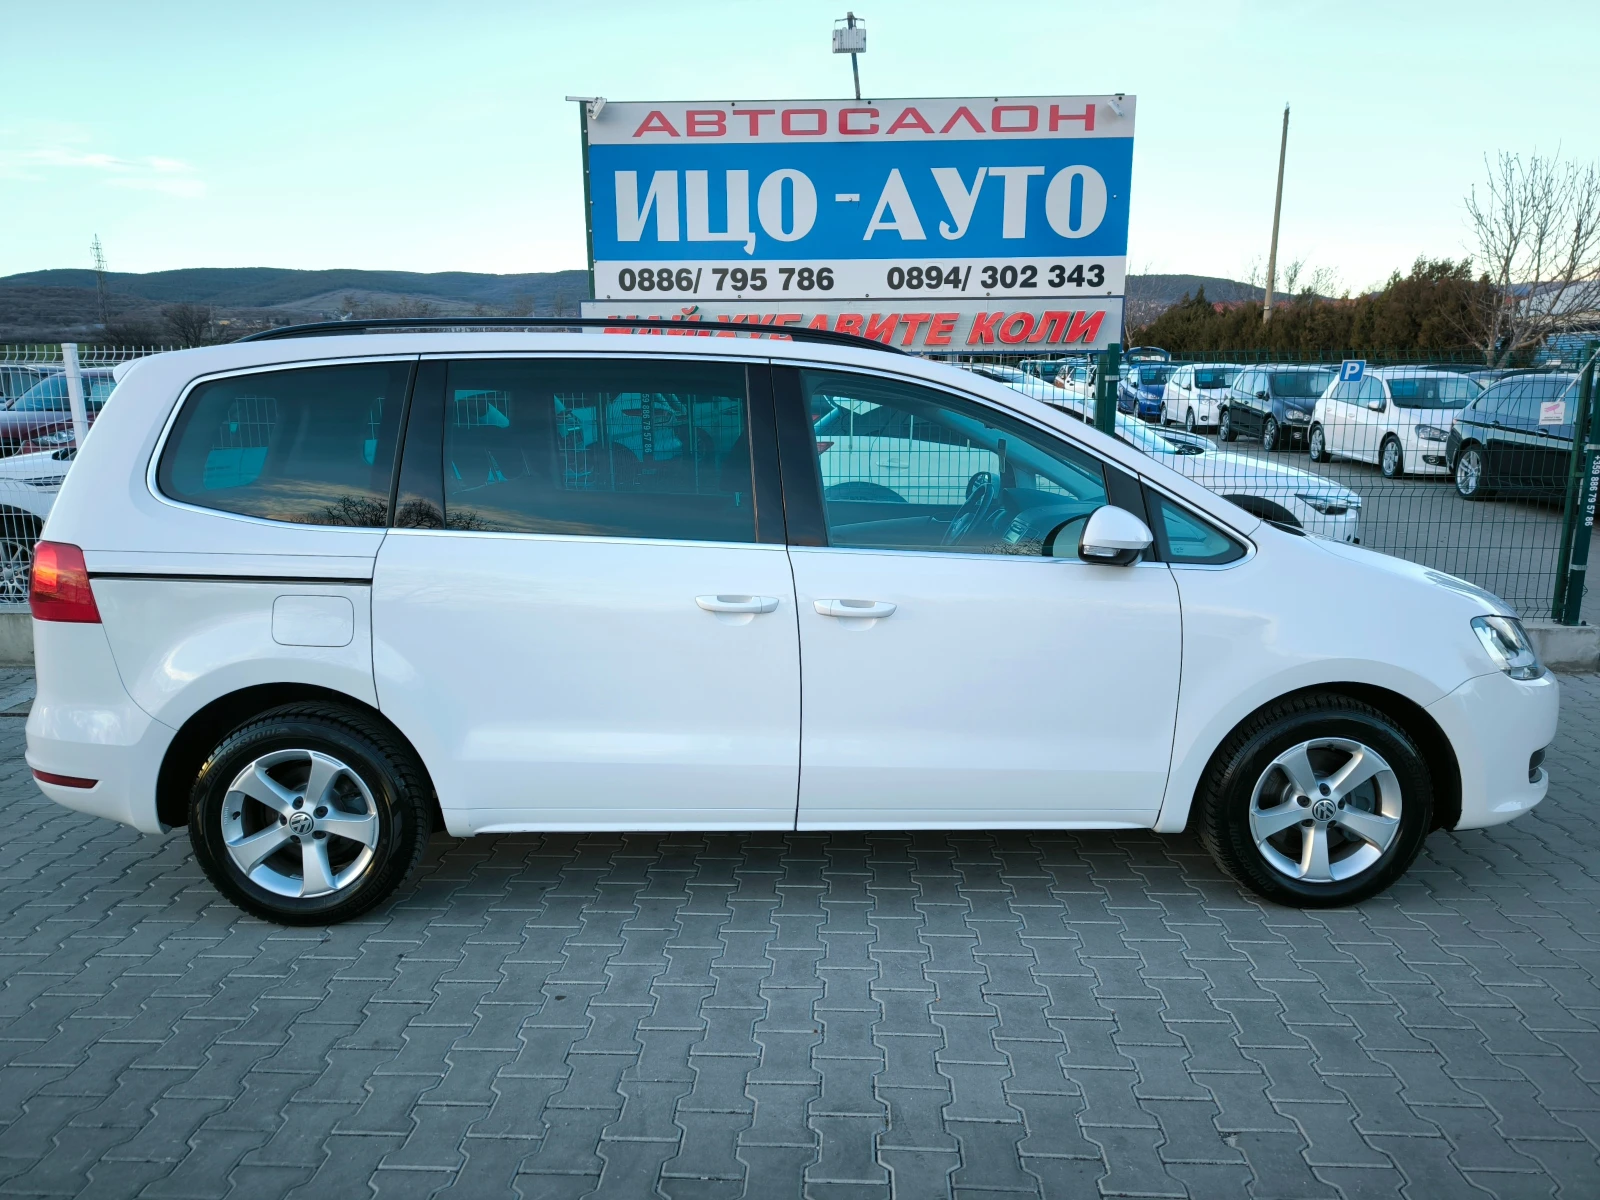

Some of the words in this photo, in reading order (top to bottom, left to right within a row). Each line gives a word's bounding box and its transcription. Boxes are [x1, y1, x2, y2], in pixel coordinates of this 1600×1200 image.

[632, 104, 1096, 138] АВТОСАЛОН
[614, 168, 818, 256] ИЦО
[618, 267, 702, 293] 0886/
[712, 267, 768, 292] 795
[778, 267, 835, 291] 786
[887, 265, 972, 292] 0894/
[980, 264, 1038, 290] 302
[1047, 263, 1105, 289] 343
[966, 310, 1106, 344] КОЛИ
[1344, 363, 1360, 380] P
[643, 421, 651, 431] 79
[643, 432, 652, 442] 57
[1590, 477, 1599, 491] 886
[1588, 493, 1597, 503] 79
[1587, 505, 1595, 515] 57
[1585, 517, 1594, 526] 86
